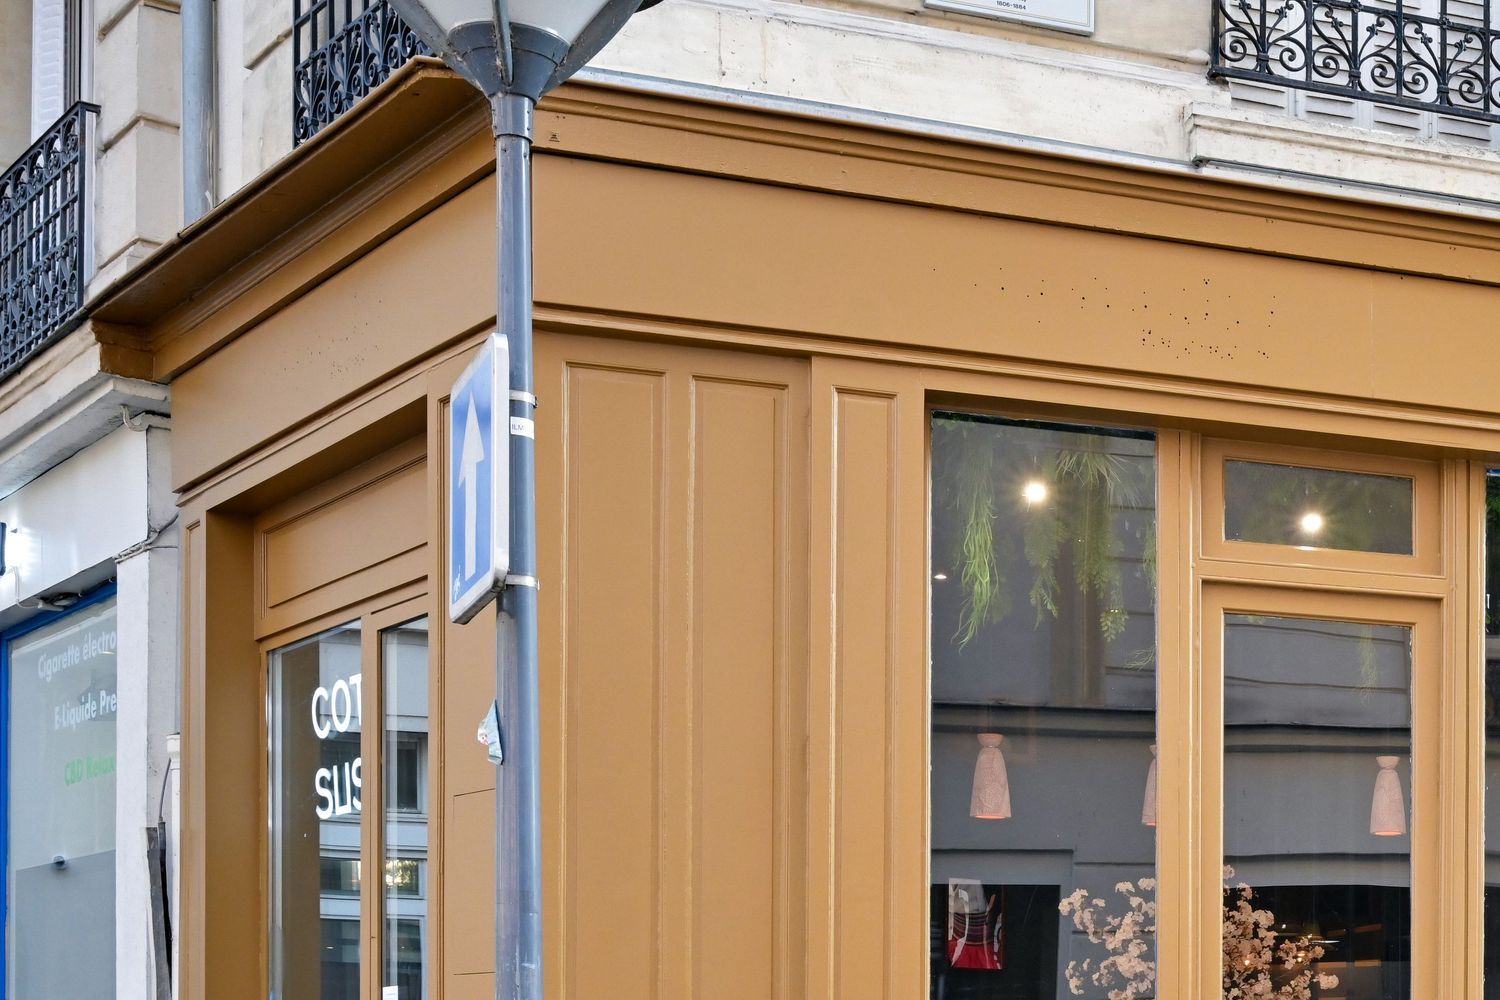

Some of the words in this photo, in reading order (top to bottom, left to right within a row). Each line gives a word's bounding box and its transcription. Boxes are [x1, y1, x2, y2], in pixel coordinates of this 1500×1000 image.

[38, 644, 80, 683] Cigarette
[54, 692, 97, 732] E-Liquide
[64, 757, 83, 785] CBD
